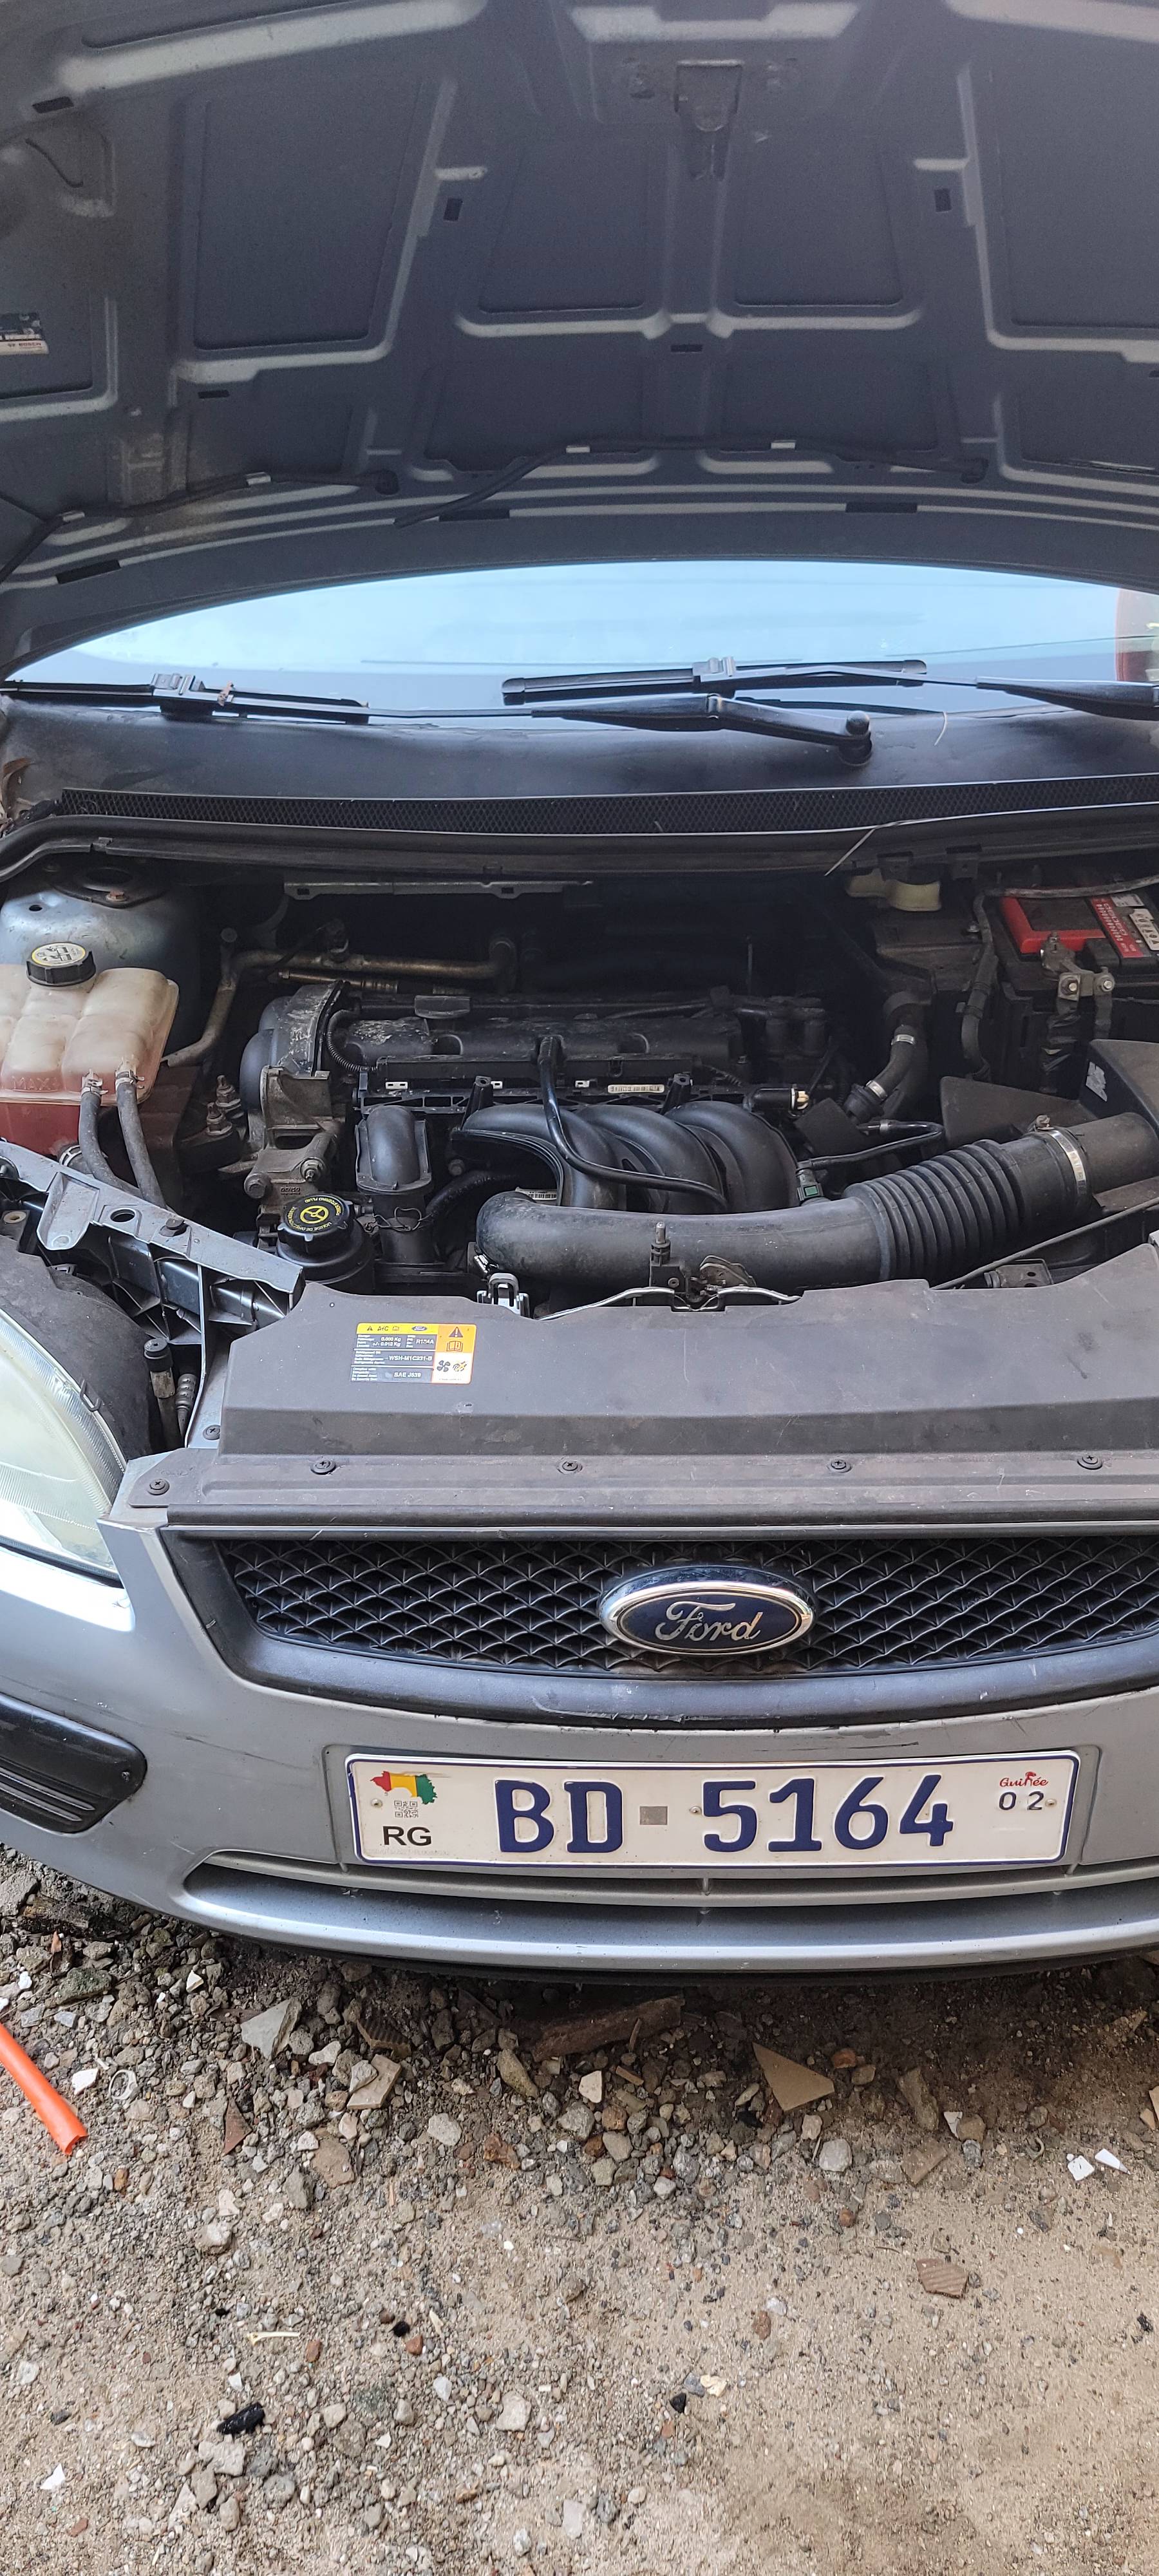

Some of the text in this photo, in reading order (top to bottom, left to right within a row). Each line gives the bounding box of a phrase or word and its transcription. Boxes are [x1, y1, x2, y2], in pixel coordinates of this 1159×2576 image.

[655, 1601, 763, 1642] Ford
[495, 1774, 954, 1853] BD 5164
[382, 1826, 432, 1846] RG
